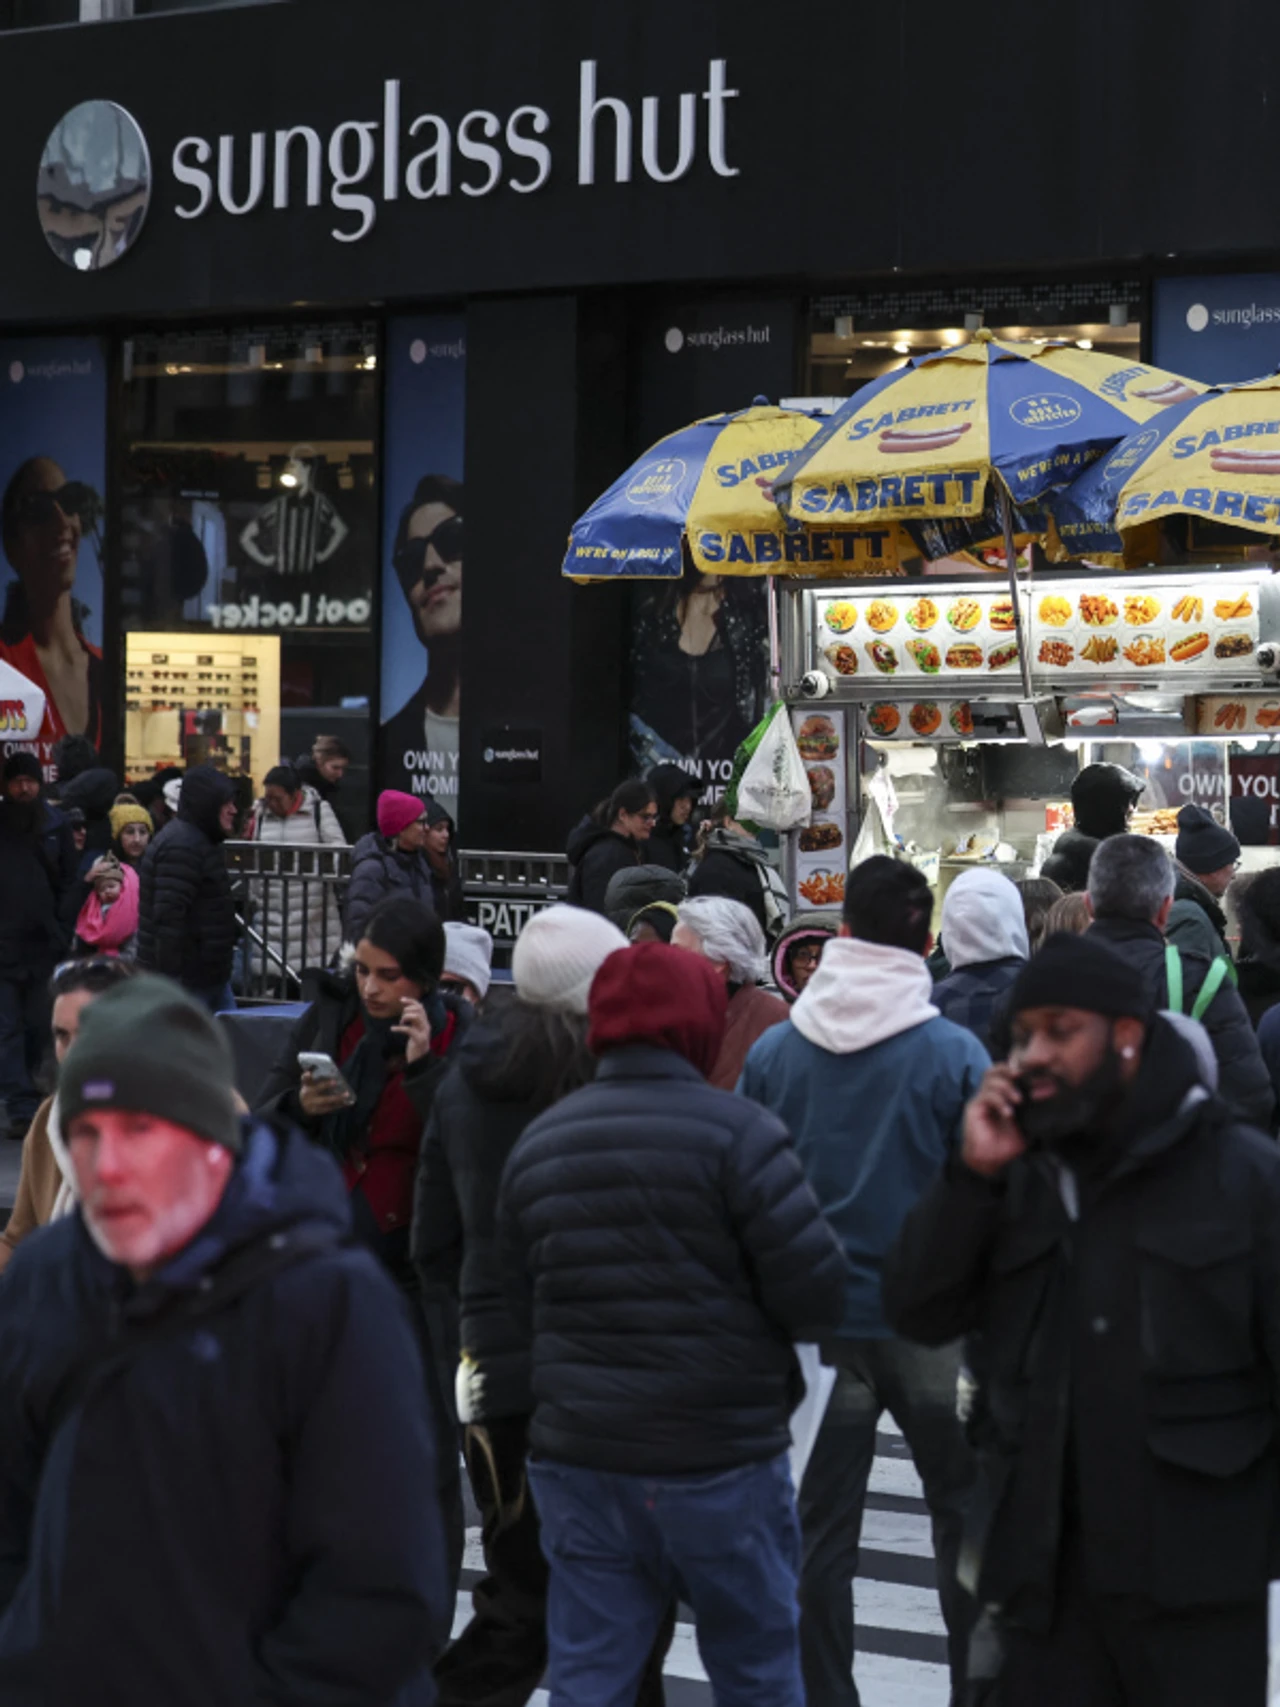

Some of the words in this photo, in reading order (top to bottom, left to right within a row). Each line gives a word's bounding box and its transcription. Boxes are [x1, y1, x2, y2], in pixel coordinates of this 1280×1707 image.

[172, 78, 552, 243] sunglass
[578, 59, 741, 187] hut
[1212, 302, 1280, 330] sunglass
[687, 325, 745, 351] sunglass
[848, 400, 976, 441] SABRETT
[716, 450, 801, 488] SABR
[799, 471, 981, 513] SABRETT
[699, 530, 890, 563] SABRETT
[403, 750, 444, 770] OWN
[707, 759, 733, 781] YO
[411, 774, 459, 795] MOM
[1178, 773, 1233, 797] OWN
